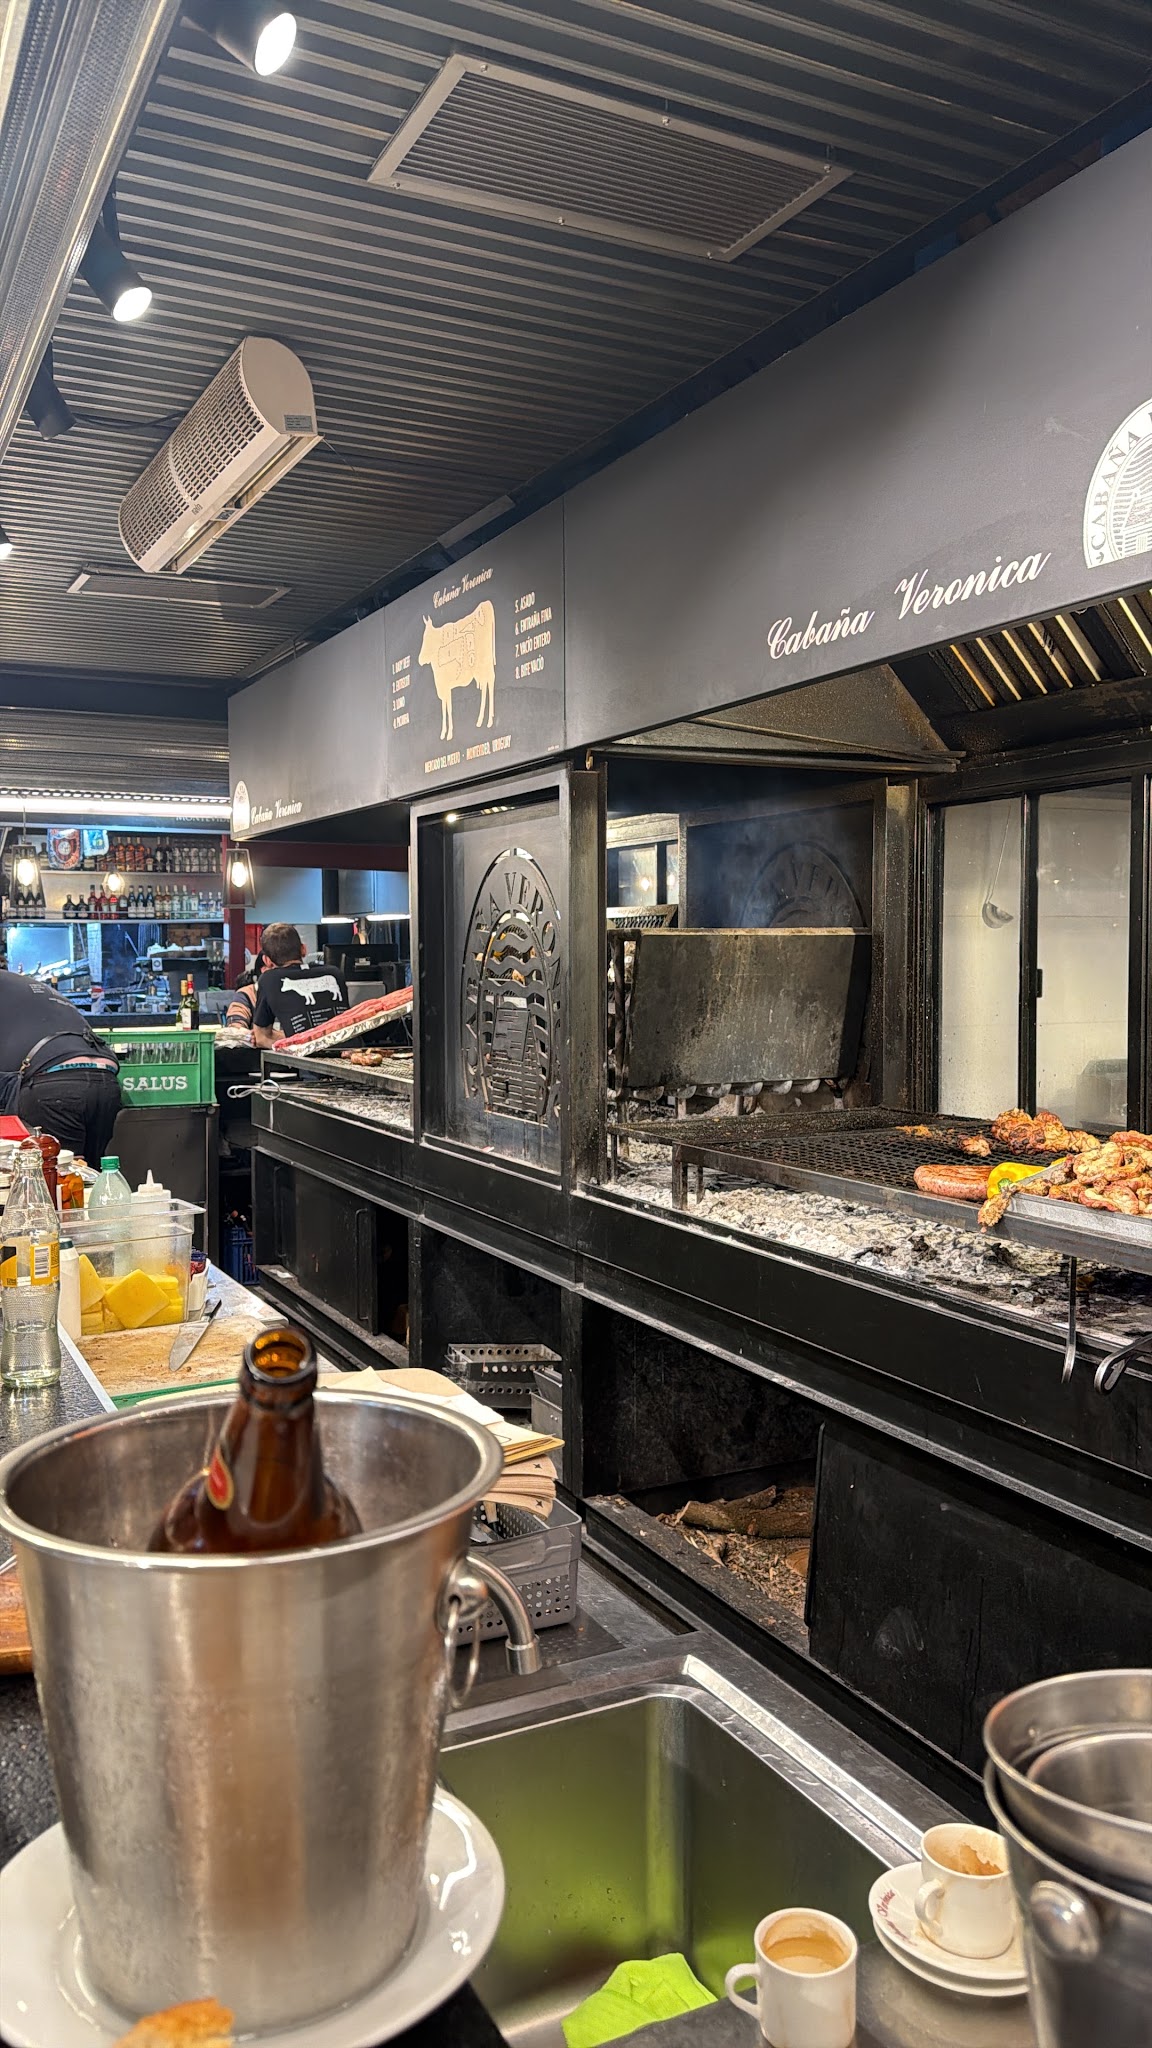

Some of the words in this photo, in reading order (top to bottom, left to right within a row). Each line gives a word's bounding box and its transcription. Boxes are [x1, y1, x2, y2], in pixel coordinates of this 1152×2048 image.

[767, 606, 875, 660] Cabaña
[894, 551, 1052, 620] Veronica
[122, 1075, 188, 1091] SALUS
